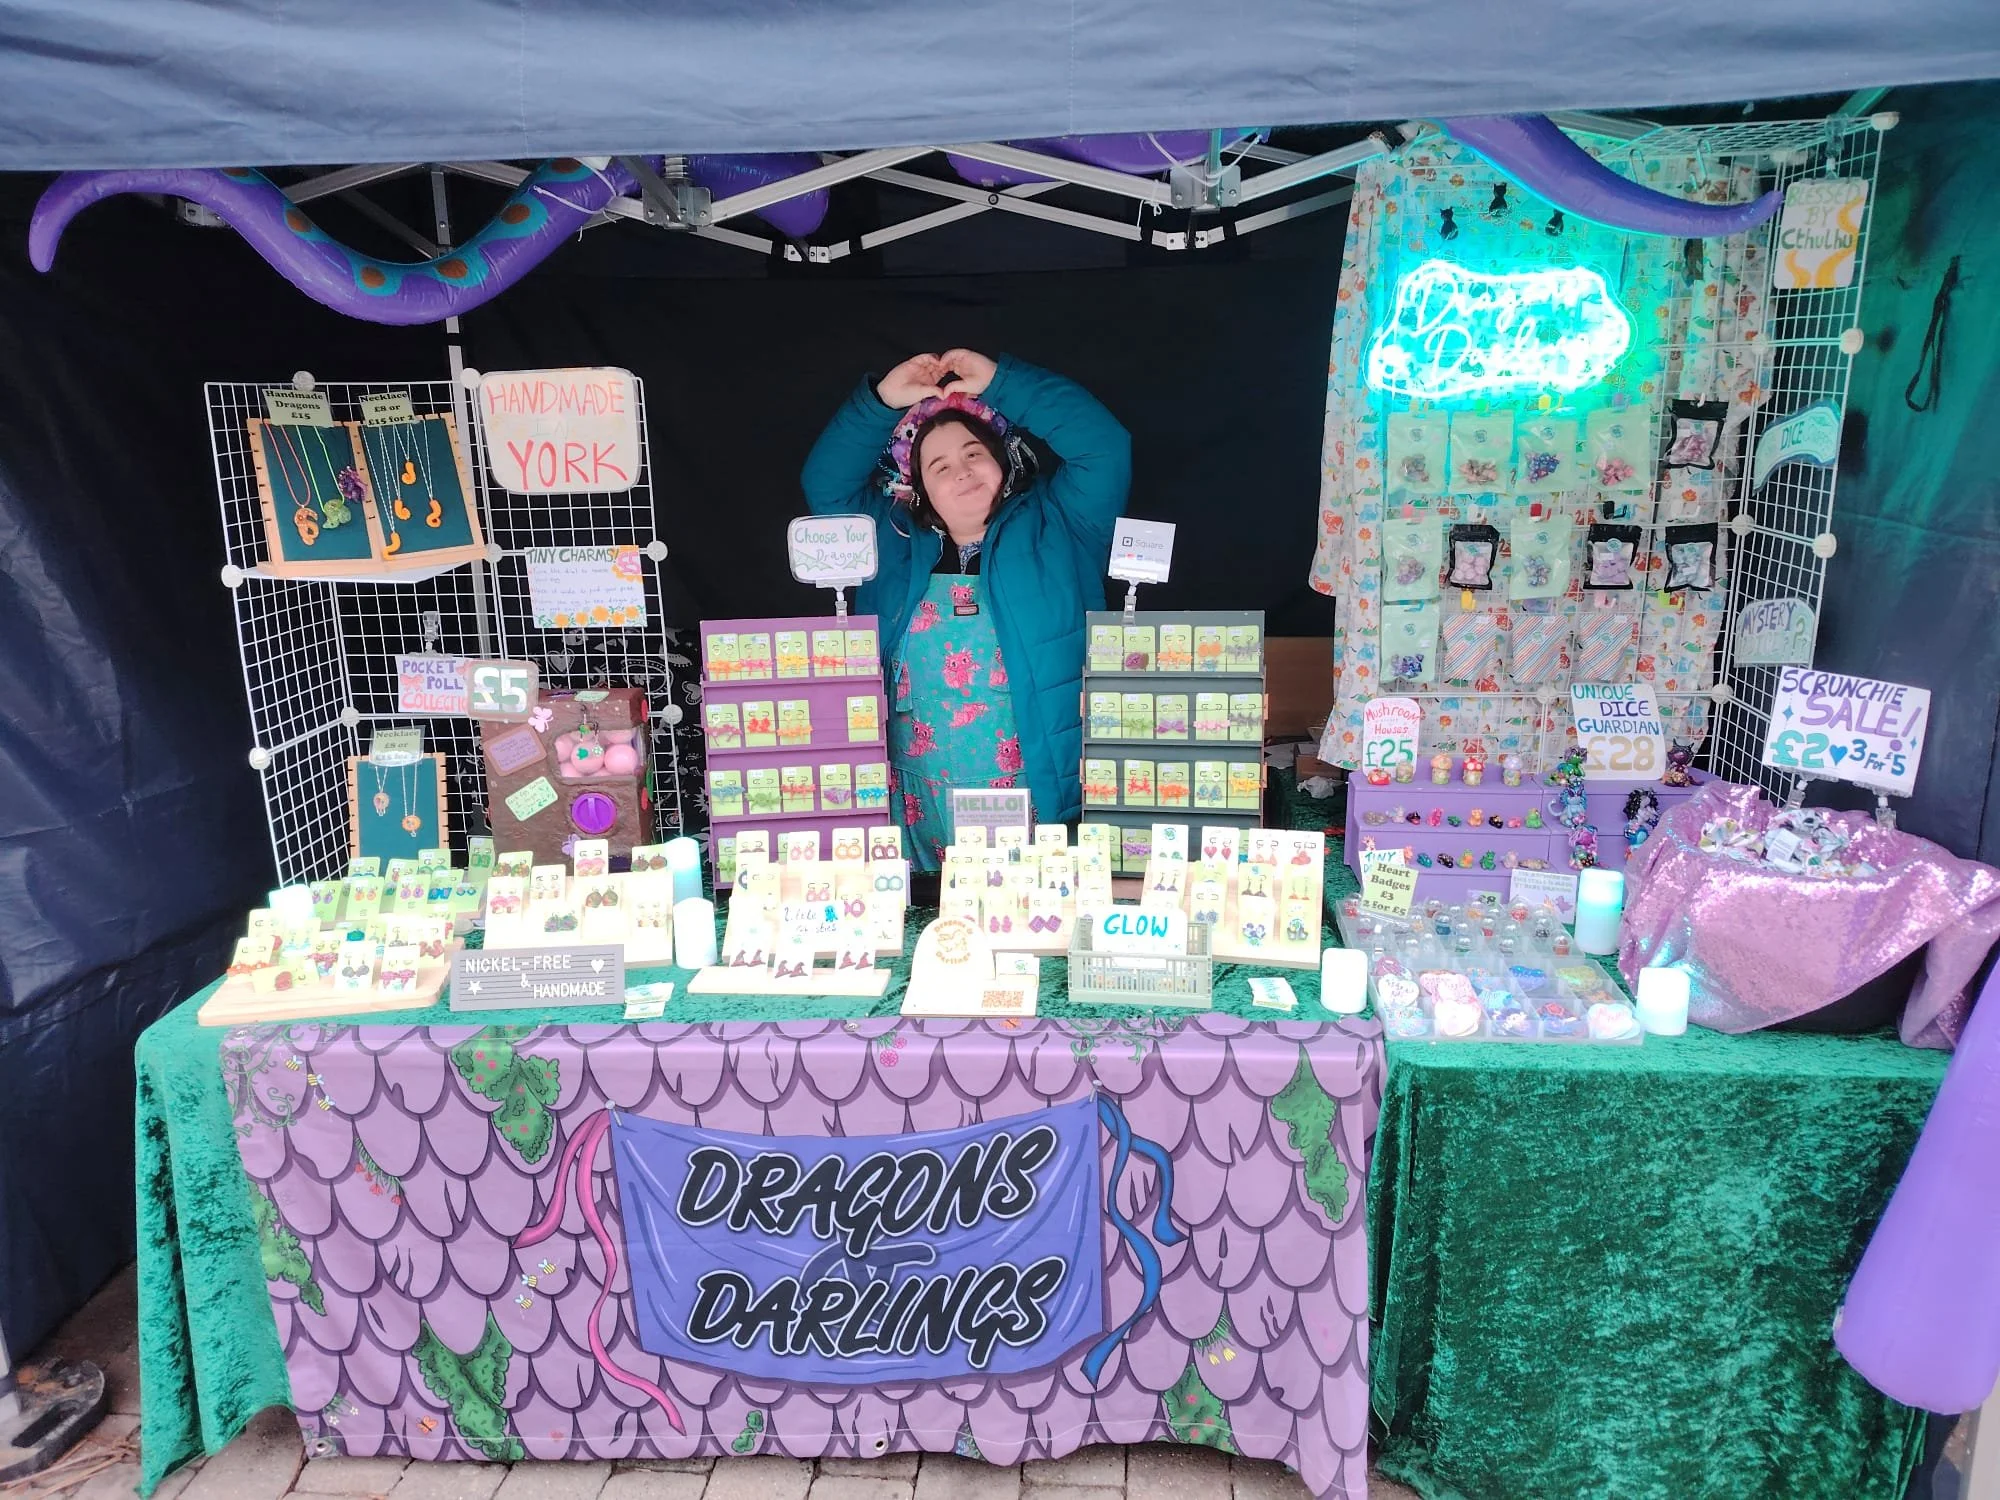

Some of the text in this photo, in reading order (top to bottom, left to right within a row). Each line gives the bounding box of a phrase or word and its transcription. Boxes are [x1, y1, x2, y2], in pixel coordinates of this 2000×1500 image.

[1805, 206, 1835, 226] BY
[265, 390, 323, 400] Handmade
[359, 392, 408, 402] Necklace
[486, 381, 625, 416] HANDMADE
[275, 400, 321, 410] Dragons
[291, 412, 311, 420] £15
[368, 417, 386, 425] £15
[1781, 420, 1805, 450] DICE
[507, 440, 628, 490] YORK
[794, 525, 869, 544] Choose Your
[526, 548, 558, 564] TINY
[558, 548, 619, 563] CHARMS!
[1741, 601, 1797, 638] MYSTERY
[402, 660, 456, 674] POCKET
[427, 675, 465, 690] POLL
[474, 667, 528, 712] £5
[1782, 669, 1908, 706] SCRUNCHIE
[1572, 684, 1635, 700] UNIQUE
[1600, 700, 1651, 717] DICE
[1375, 723, 1409, 735] Houses
[1577, 718, 1660, 735] GUARDIAN
[1800, 691, 1923, 751] SALE!
[376, 730, 419, 738] Necklace
[1364, 738, 1413, 767] £25
[1584, 735, 1655, 771] £28
[1770, 729, 1829, 769] £2
[1849, 738, 1868, 761] 3
[956, 797, 1024, 812] HELLO!
[1364, 851, 1397, 862] TINY
[1377, 862, 1411, 878] Heart
[1371, 875, 1411, 891] Badges
[1380, 890, 1394, 900] £3
[1371, 901, 1390, 911] for
[1392, 905, 1407, 916] £5
[1103, 914, 1168, 938] GLOW
[465, 954, 572, 974] NICKEL-FREE
[520, 973, 532, 988] &
[533, 981, 606, 999] HANDMADE
[676, 1125, 1058, 1258] DRAGONS
[686, 1255, 1067, 1369] DARLINGS
